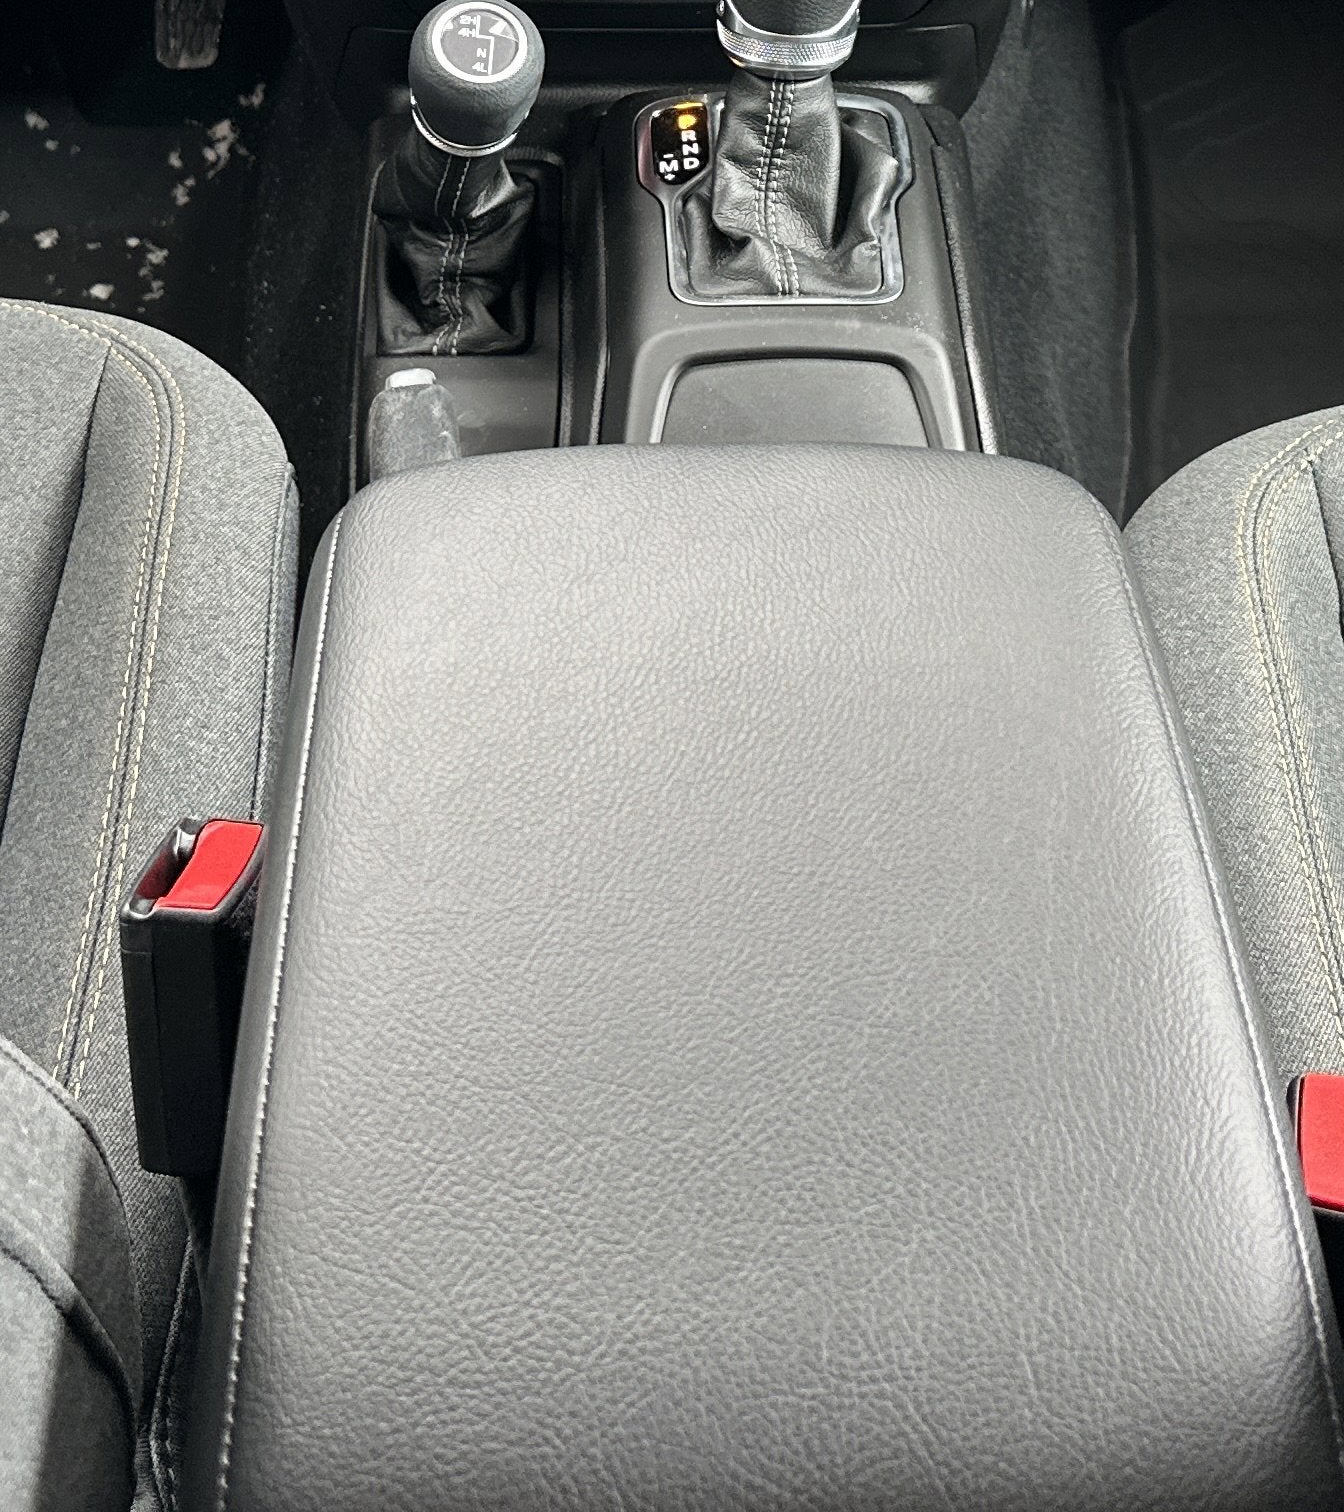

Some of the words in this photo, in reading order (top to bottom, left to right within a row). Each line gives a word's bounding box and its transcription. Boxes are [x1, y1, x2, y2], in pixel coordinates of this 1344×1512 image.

[457, 27, 476, 38] 4H
[476, 47, 488, 59] N
[471, 61, 488, 73] 4L
[681, 129, 697, 142] R
[682, 142, 699, 156] N
[659, 159, 679, 173] M
[683, 157, 700, 170] D
